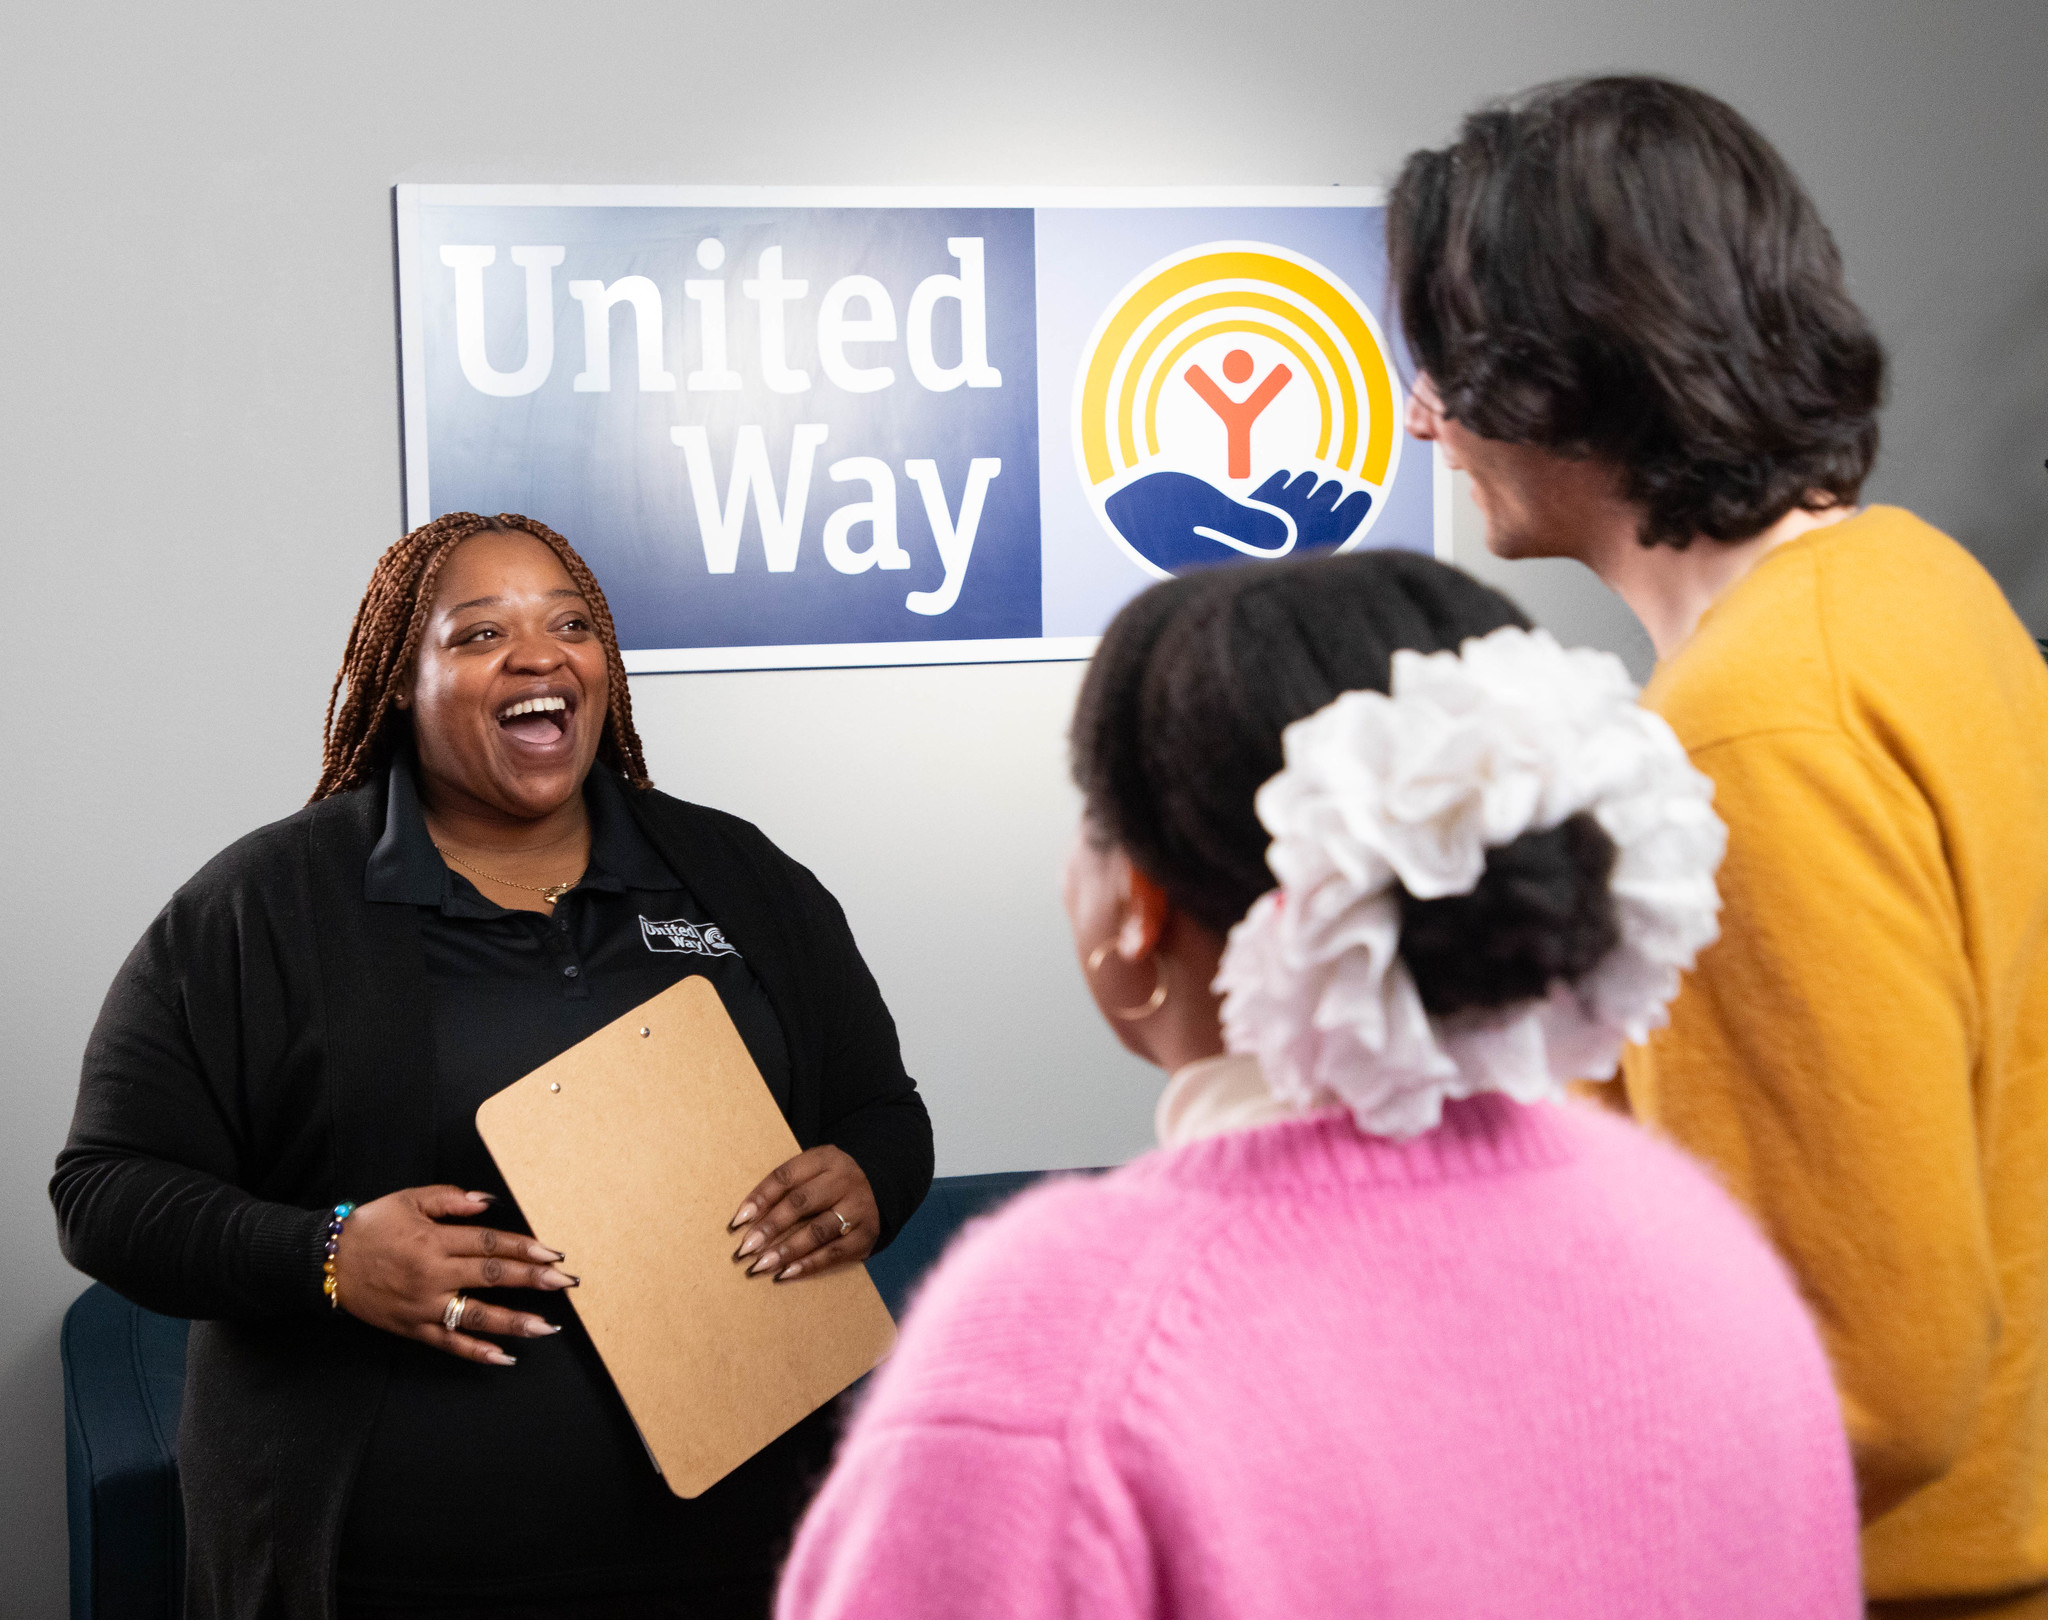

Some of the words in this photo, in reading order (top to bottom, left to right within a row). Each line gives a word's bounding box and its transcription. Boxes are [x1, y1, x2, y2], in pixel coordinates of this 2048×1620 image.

[439, 237, 1002, 397] United
[670, 423, 1002, 616] Way
[643, 921, 698, 938] United
[668, 935, 702, 951] Way
